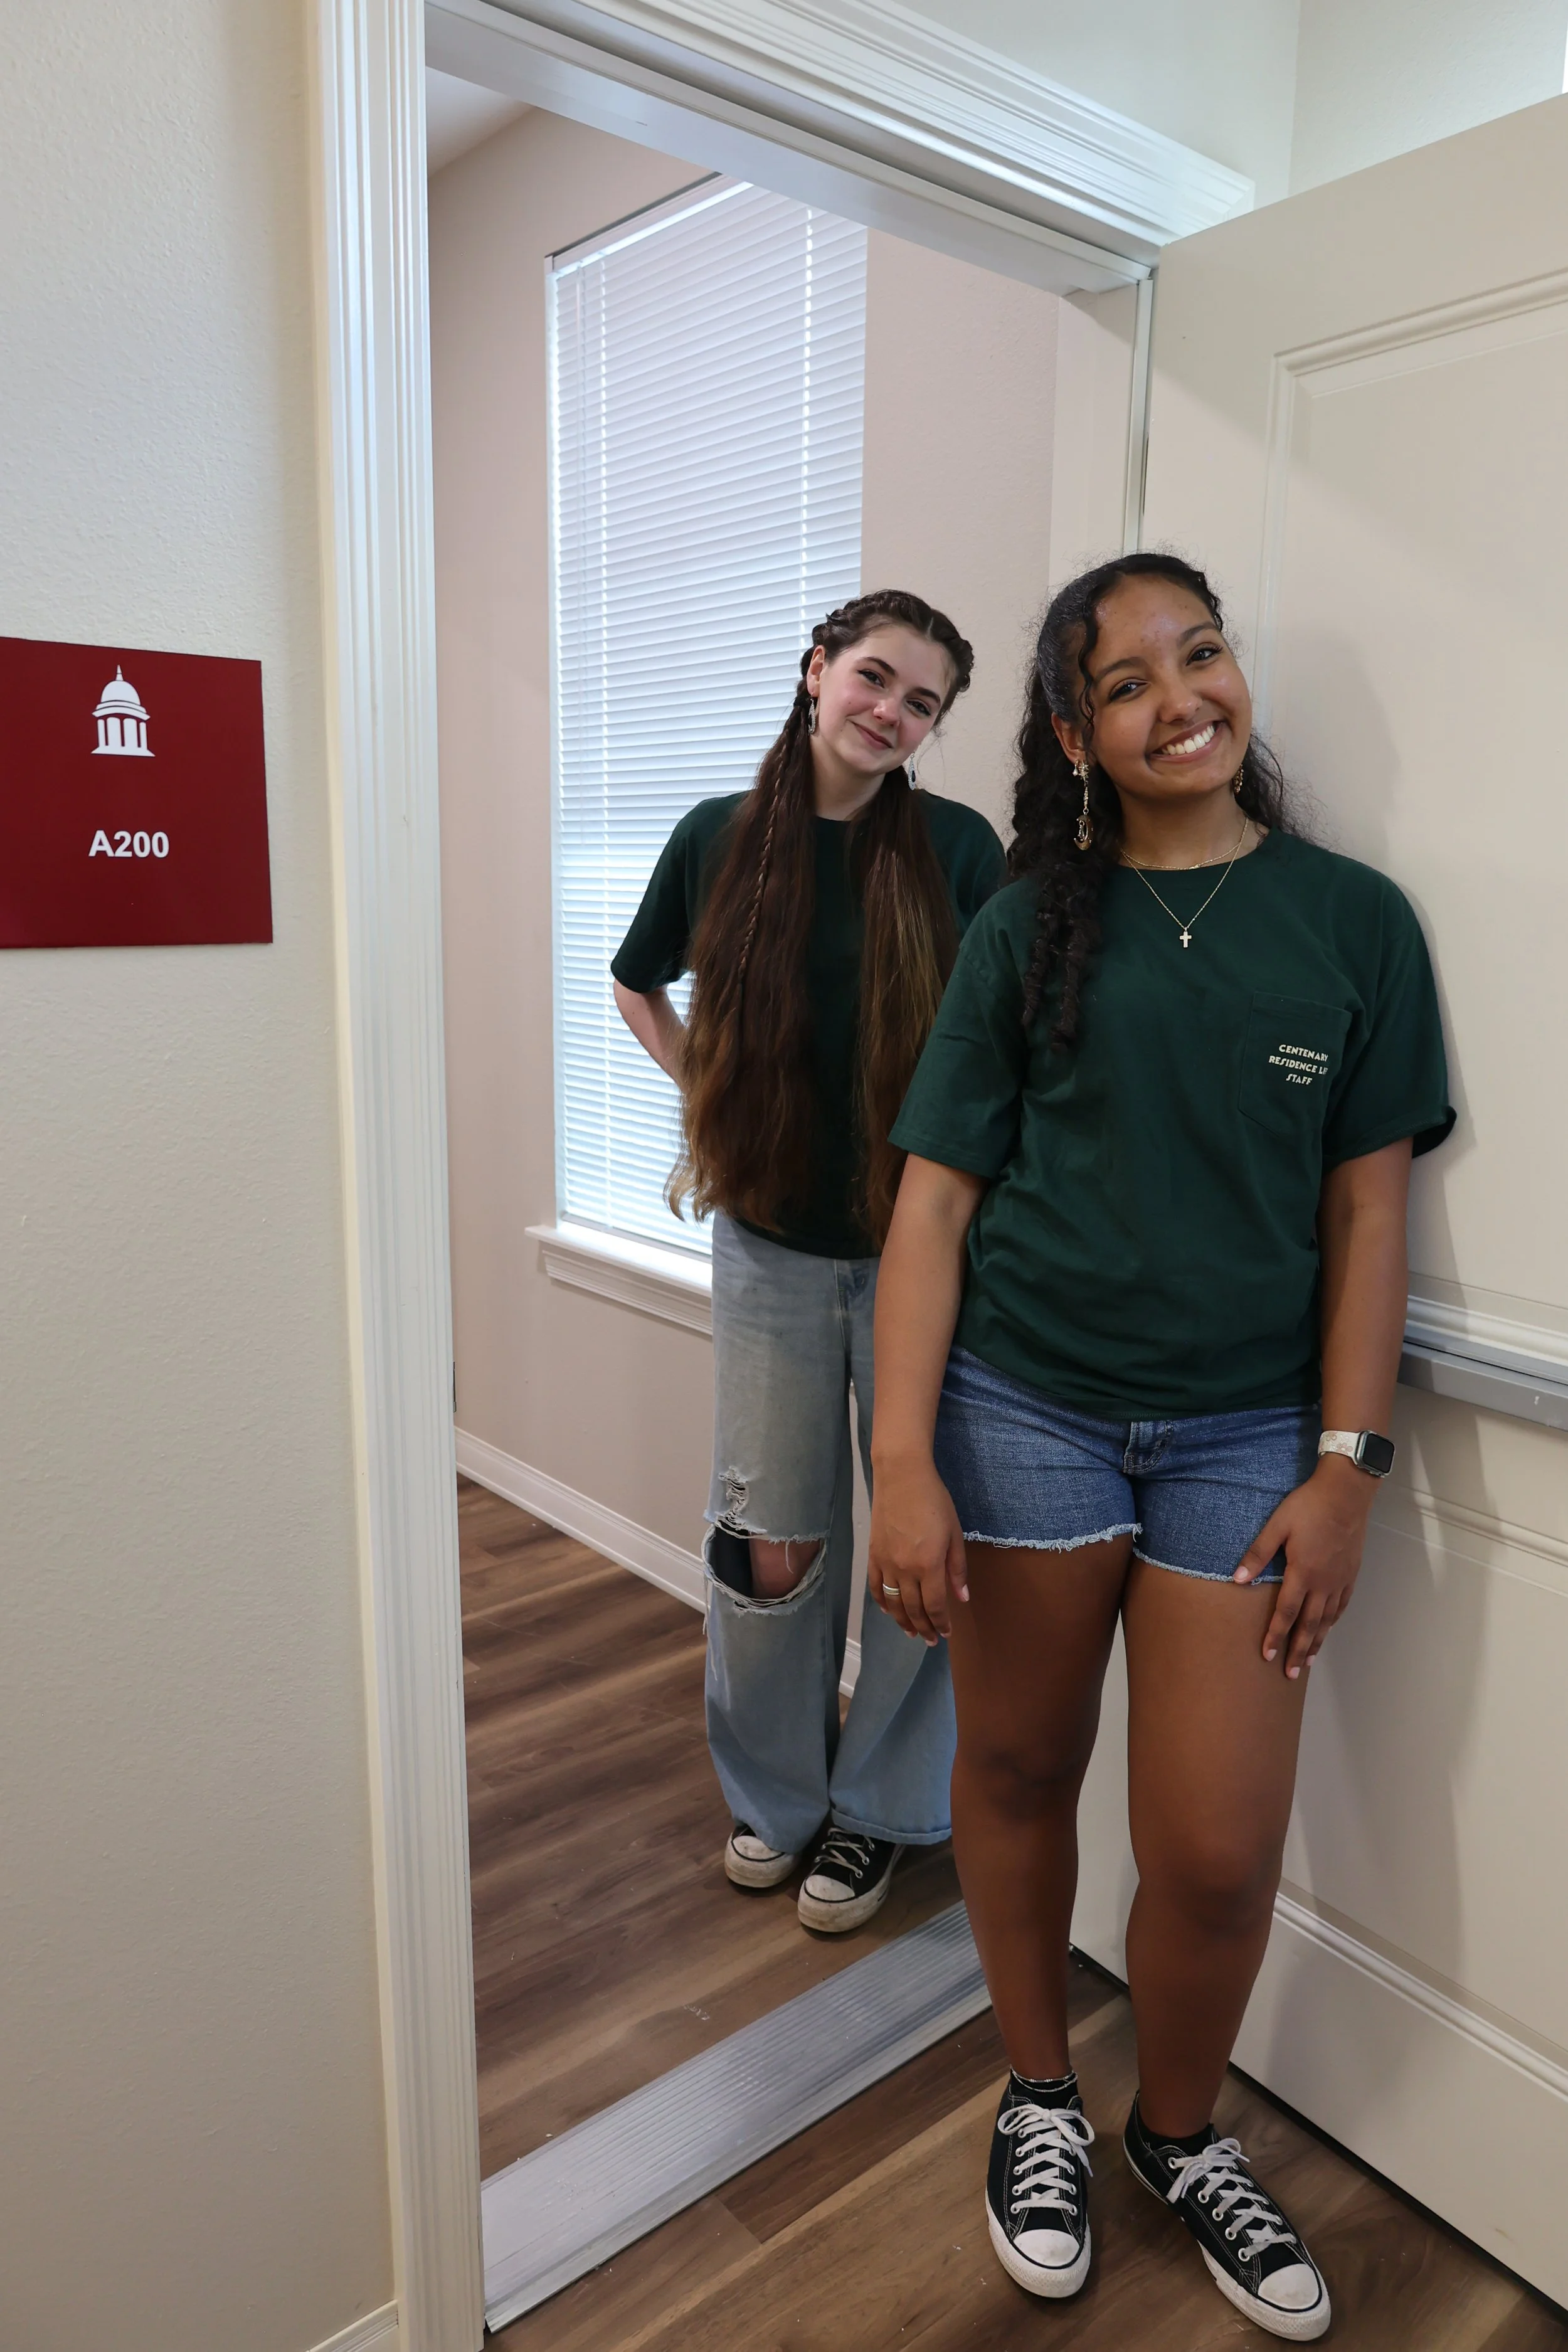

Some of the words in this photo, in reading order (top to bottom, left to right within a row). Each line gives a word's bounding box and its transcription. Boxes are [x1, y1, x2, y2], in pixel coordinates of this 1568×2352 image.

[88, 830, 169, 858] A200
[1278, 1044, 1328, 1062] CENTENARY
[1268, 1055, 1318, 1073] RESIDENCE
[1286, 1073, 1313, 1085] STAFF
